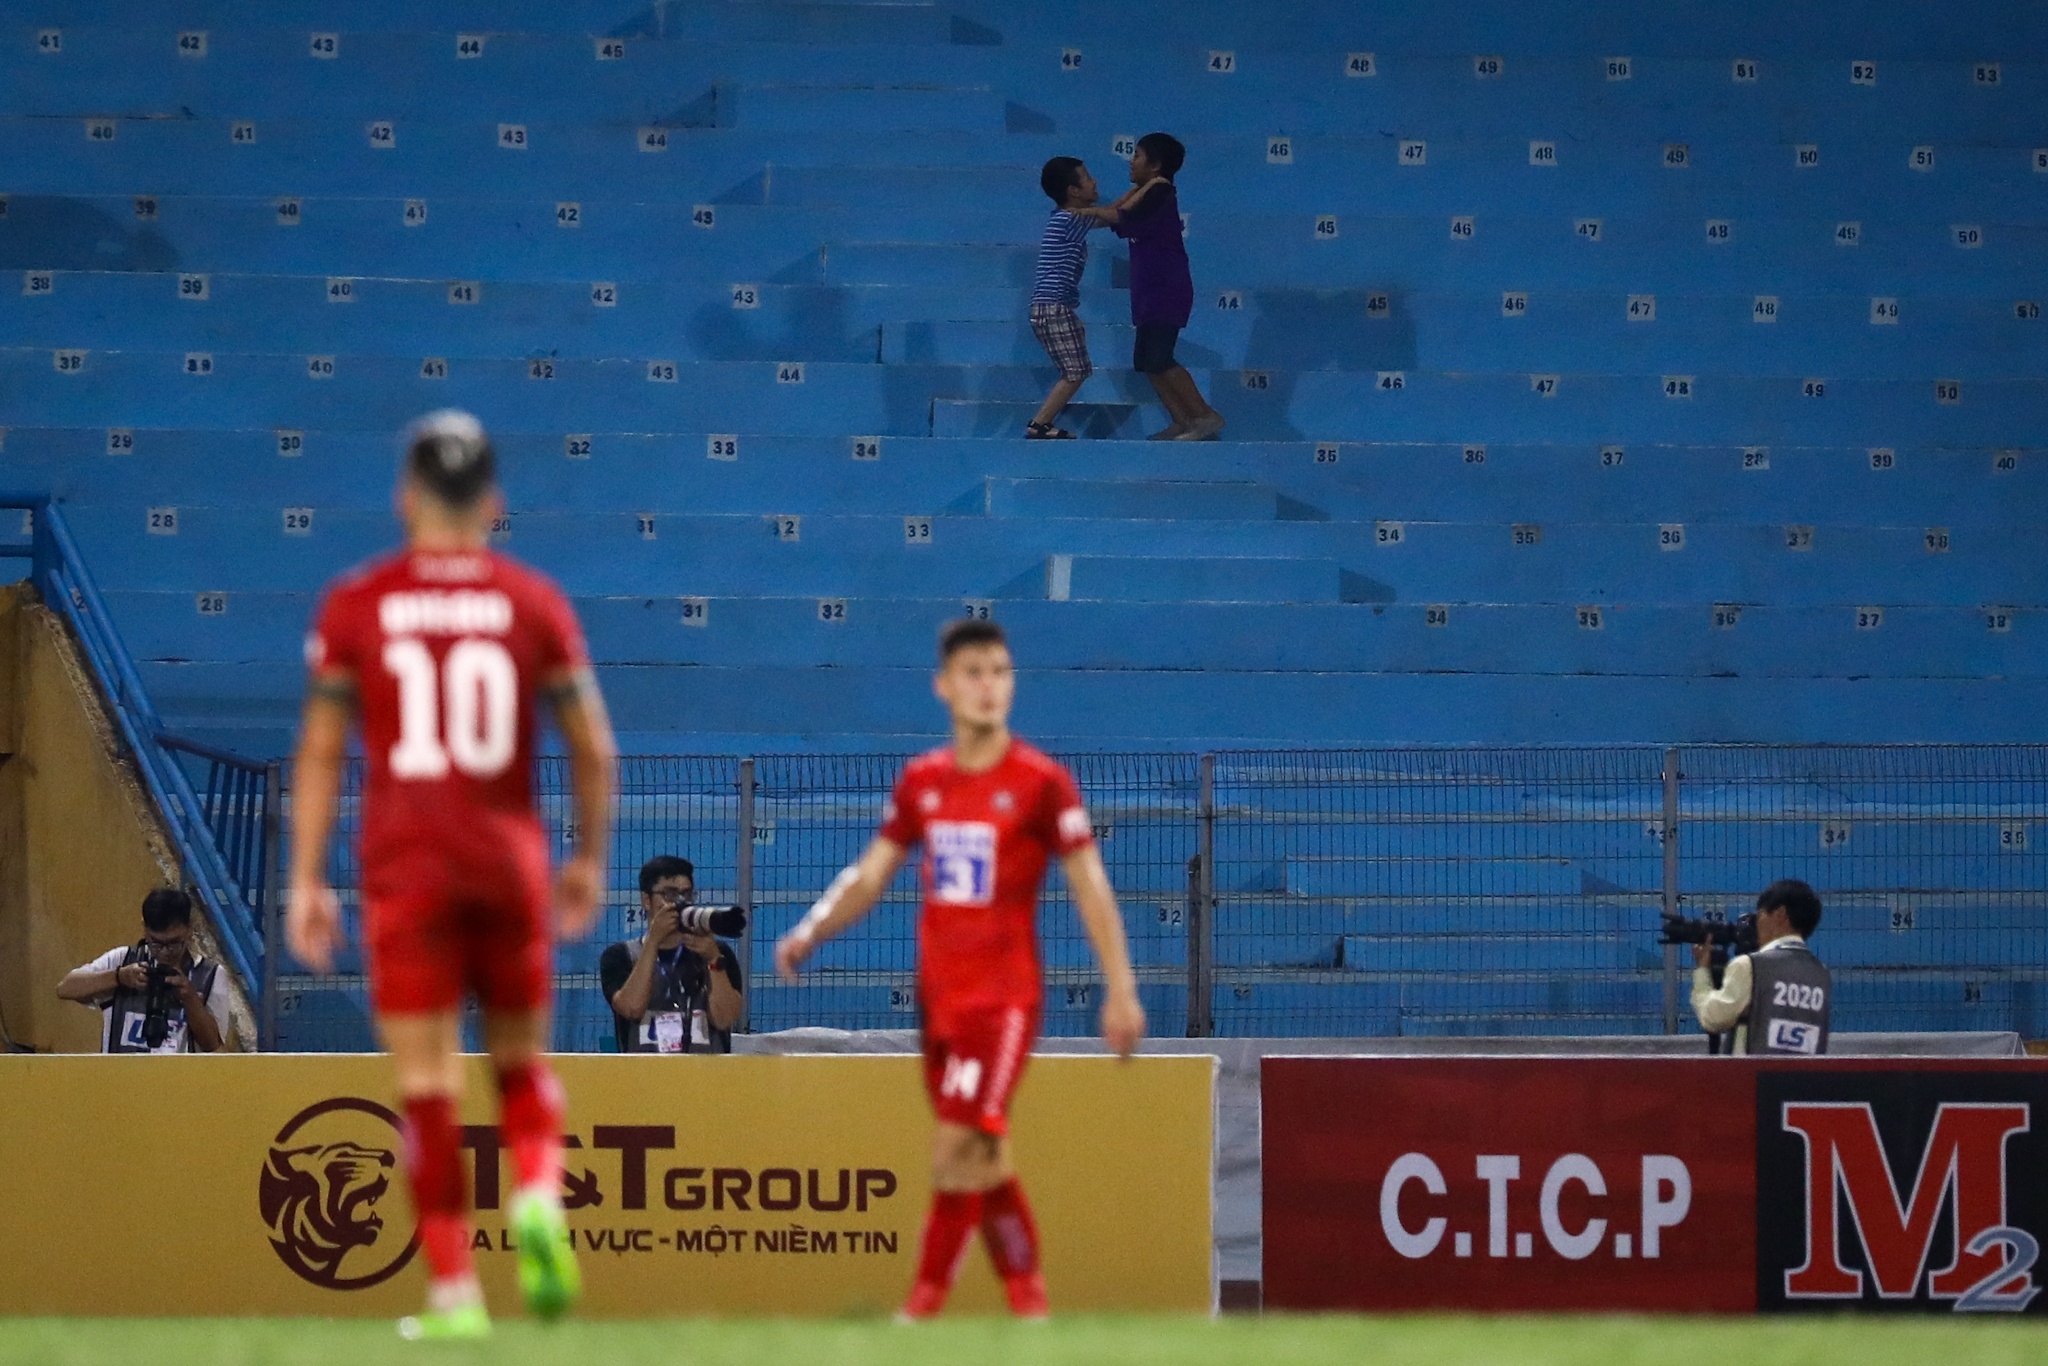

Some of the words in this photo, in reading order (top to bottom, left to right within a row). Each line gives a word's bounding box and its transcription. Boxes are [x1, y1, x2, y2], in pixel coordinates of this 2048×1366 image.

[40, 35, 58, 47] 41
[181, 36, 199, 49] 42
[313, 38, 333, 52] 43
[460, 41, 479, 54] 44
[603, 45, 622, 57] 45
[1212, 57, 1231, 69] 47
[1351, 59, 1369, 71] 48
[1479, 61, 1497, 73] 49
[1609, 63, 1626, 75] 50
[1737, 64, 1753, 77] 51
[1854, 66, 1873, 79] 52
[1977, 68, 1996, 82] 53
[93, 127, 112, 138] 40
[235, 127, 251, 140] 41
[372, 128, 390, 140] 42
[503, 130, 524, 143] 43
[646, 134, 665, 146] 44
[1115, 141, 1133, 155] 45
[1270, 143, 1288, 155] 46
[1406, 146, 1422, 158] 47
[1535, 147, 1552, 159] 48
[1667, 150, 1685, 164] 49
[1917, 151, 1931, 164] 51
[279, 203, 297, 216] 40
[407, 206, 423, 219] 41
[558, 208, 577, 221] 42
[694, 211, 712, 224] 43
[1318, 221, 1334, 234] 45
[1453, 222, 1471, 235] 46
[1579, 224, 1597, 236] 47
[1709, 225, 1727, 238] 48
[1959, 231, 1978, 243] 50
[31, 277, 49, 290] 38
[183, 279, 202, 294] 39
[331, 283, 350, 296] 40
[454, 287, 471, 300] 41
[593, 289, 612, 302] 42
[734, 291, 753, 304] 43
[1368, 297, 1386, 311] 45
[1505, 298, 1524, 310] 46
[1631, 301, 1650, 315] 47
[1755, 302, 1774, 315] 48
[1877, 303, 1898, 316] 49
[60, 356, 80, 369] 38
[311, 360, 332, 373] 40
[424, 362, 443, 376] 41
[533, 364, 552, 378] 42
[653, 366, 673, 379] 43
[781, 369, 799, 381] 44
[1382, 377, 1401, 388] 46
[1537, 380, 1553, 392] 47
[1667, 381, 1688, 394] 48
[1806, 383, 1823, 396] 49
[1938, 385, 1957, 399] 50
[112, 435, 132, 448] 29
[281, 436, 300, 451] 30
[569, 441, 589, 455] 32
[714, 441, 734, 455] 33
[856, 443, 876, 457] 34
[1318, 449, 1336, 462] 35
[1466, 450, 1484, 463] 36
[1604, 452, 1623, 465] 37
[1873, 454, 1892, 467] 39
[1998, 457, 2014, 469] 40
[152, 514, 173, 527] 28
[288, 515, 309, 528] 29
[908, 523, 928, 537] 33
[1379, 528, 1399, 541] 34
[1516, 532, 1535, 544] 35
[1662, 531, 1680, 544] 36
[201, 597, 223, 611] 28
[683, 603, 702, 617] 31
[823, 604, 843, 619] 32
[1427, 610, 1446, 624] 34
[1580, 611, 1598, 627] 35
[1859, 613, 1879, 626] 37
[1988, 615, 2006, 628] 38
[381, 637, 520, 781] 10
[1825, 829, 1847, 844] 34
[2002, 830, 2024, 845] 35
[1892, 911, 1913, 926] 34
[1773, 980, 1824, 1012] 2020
[1776, 1024, 1806, 1048] LS
[664, 1167, 897, 1213] GROUP
[1380, 1152, 1692, 1260] C.T.C.P
[677, 1224, 748, 1258] MỘT
[755, 1223, 837, 1254] NIỀM
[843, 1231, 898, 1254] TIN
